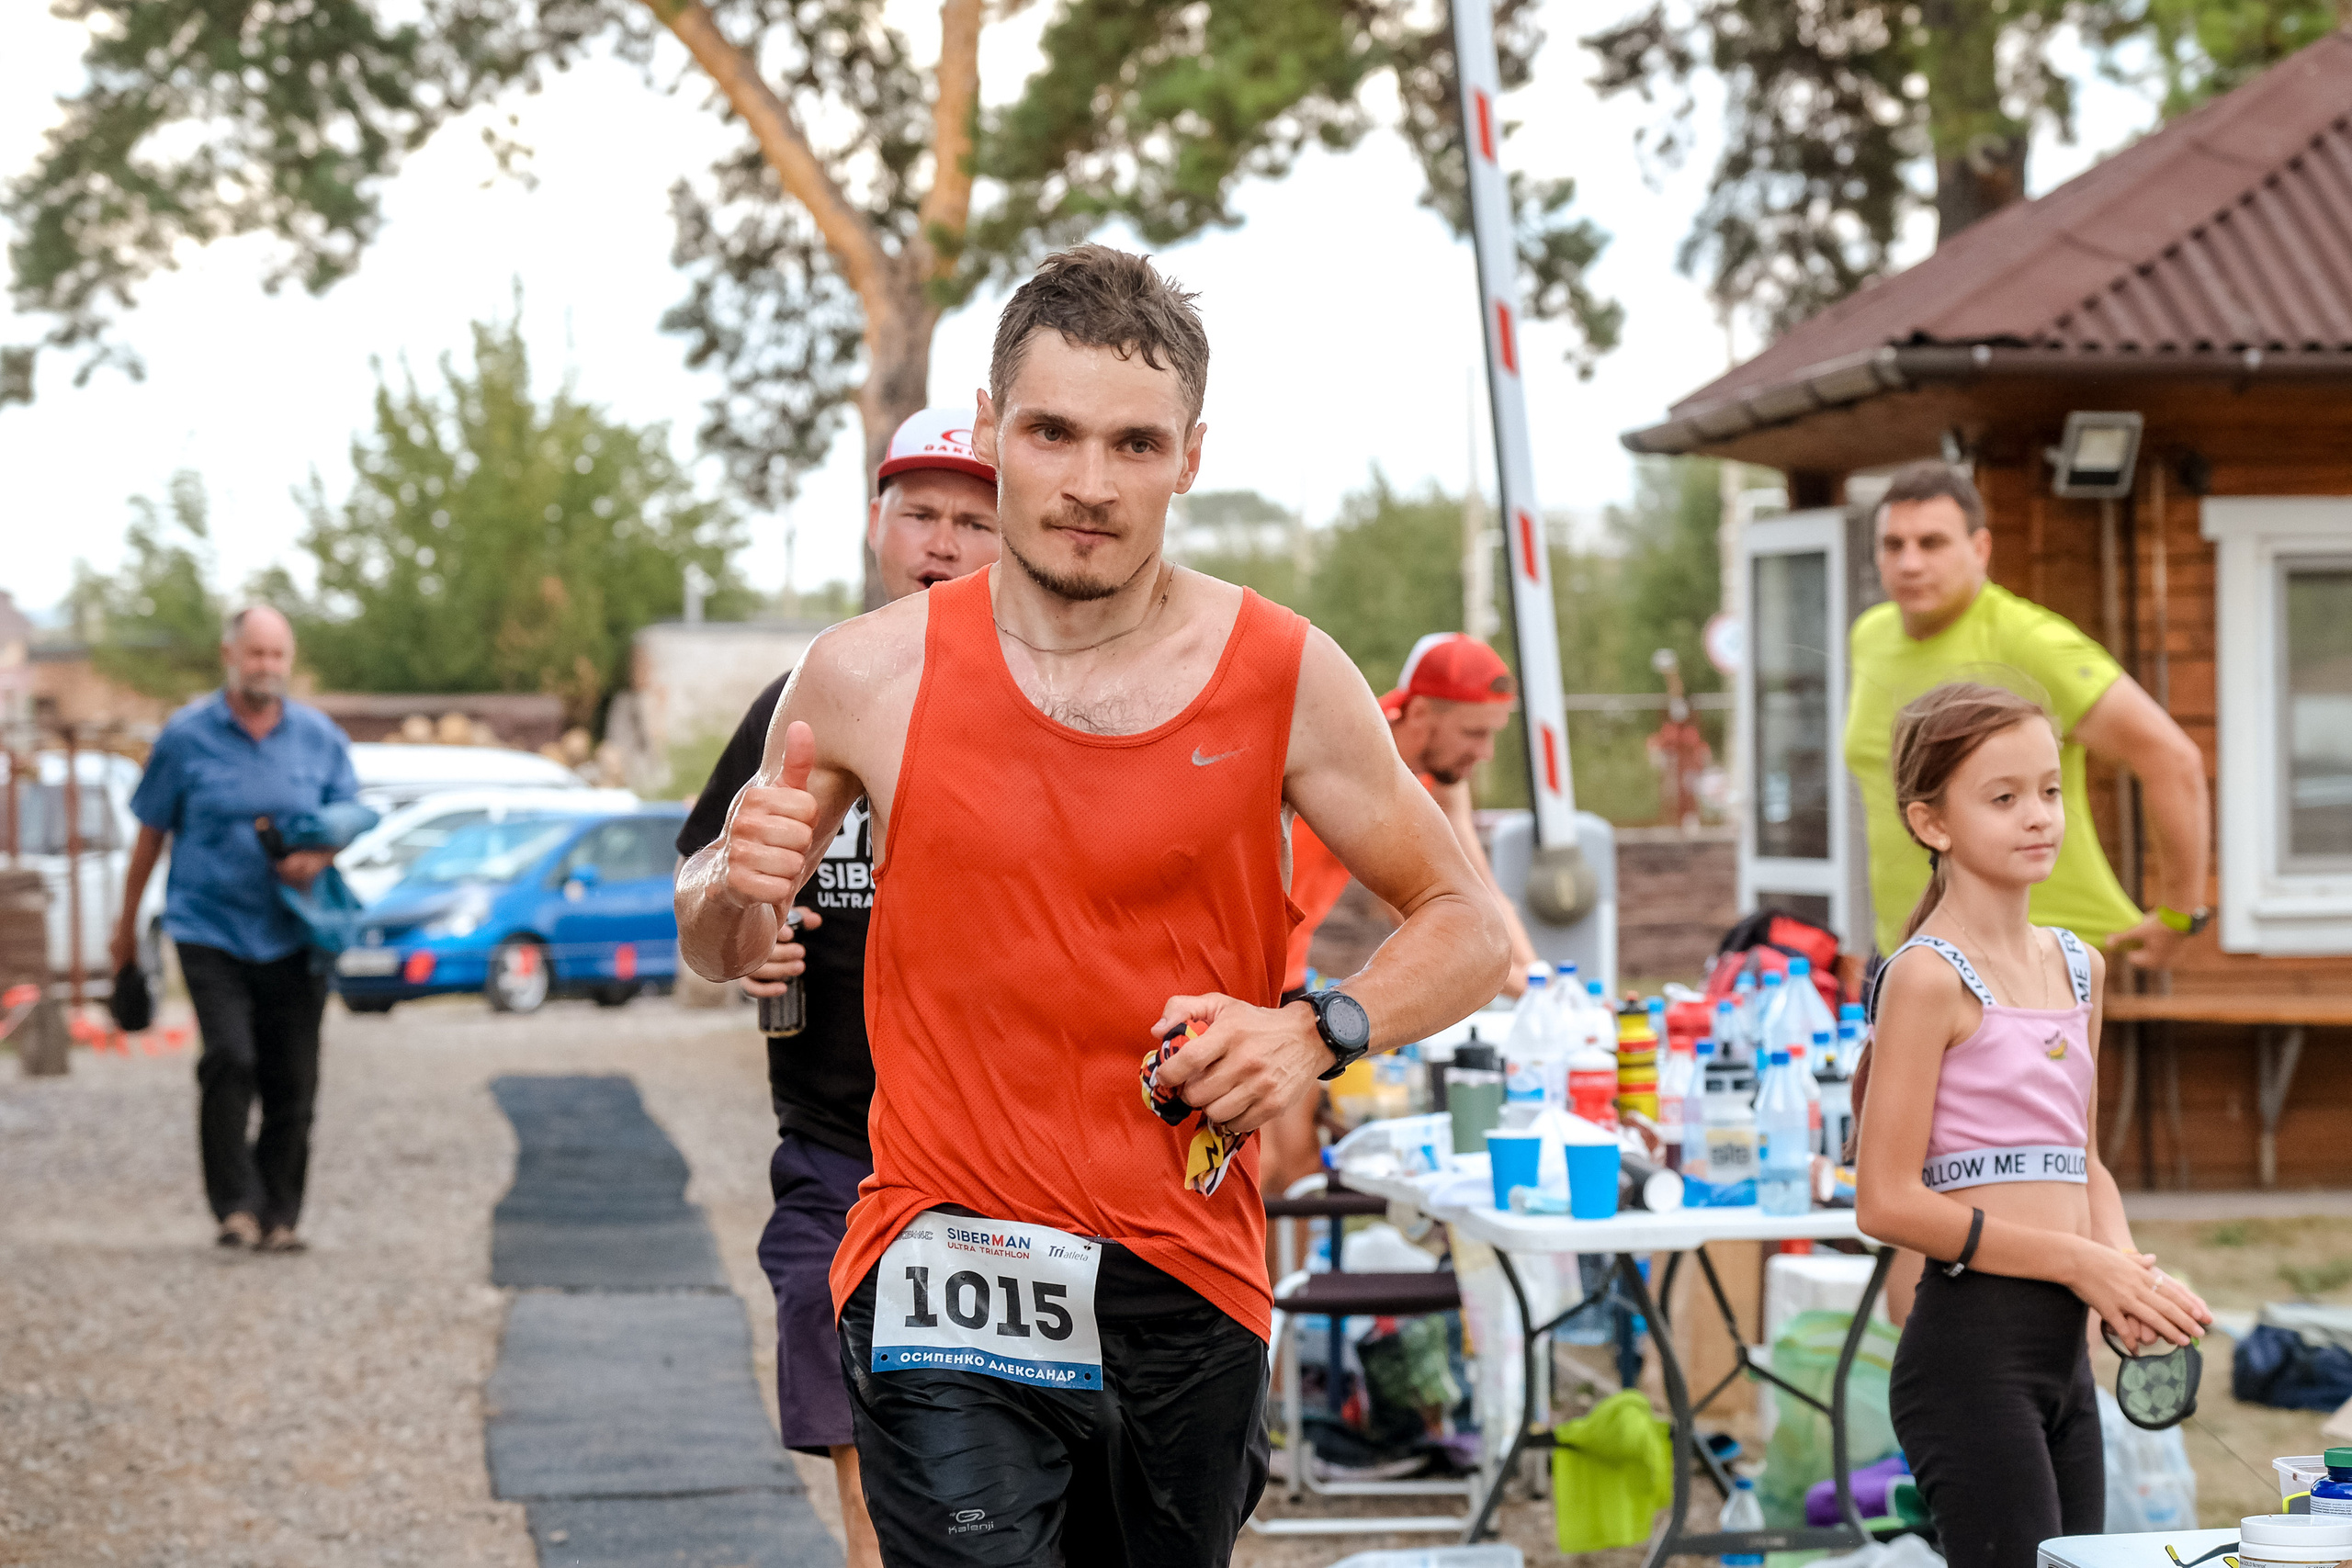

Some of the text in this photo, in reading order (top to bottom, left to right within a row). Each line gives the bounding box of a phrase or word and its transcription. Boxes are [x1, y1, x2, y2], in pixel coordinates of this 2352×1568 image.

[817, 862, 876, 889] SIB
[1995, 1154, 2027, 1176] ME
[947, 1227, 1031, 1249] SIBERMAN
[947, 1242, 1030, 1259] ULTRA TRIATHLON
[1047, 1245, 1089, 1262] Triatleta
[904, 1266, 1073, 1341] 1015
[899, 1351, 1076, 1382] ОСИПЕНКО АЛЕКСАНДР
[948, 1521, 994, 1535] Kalenji
